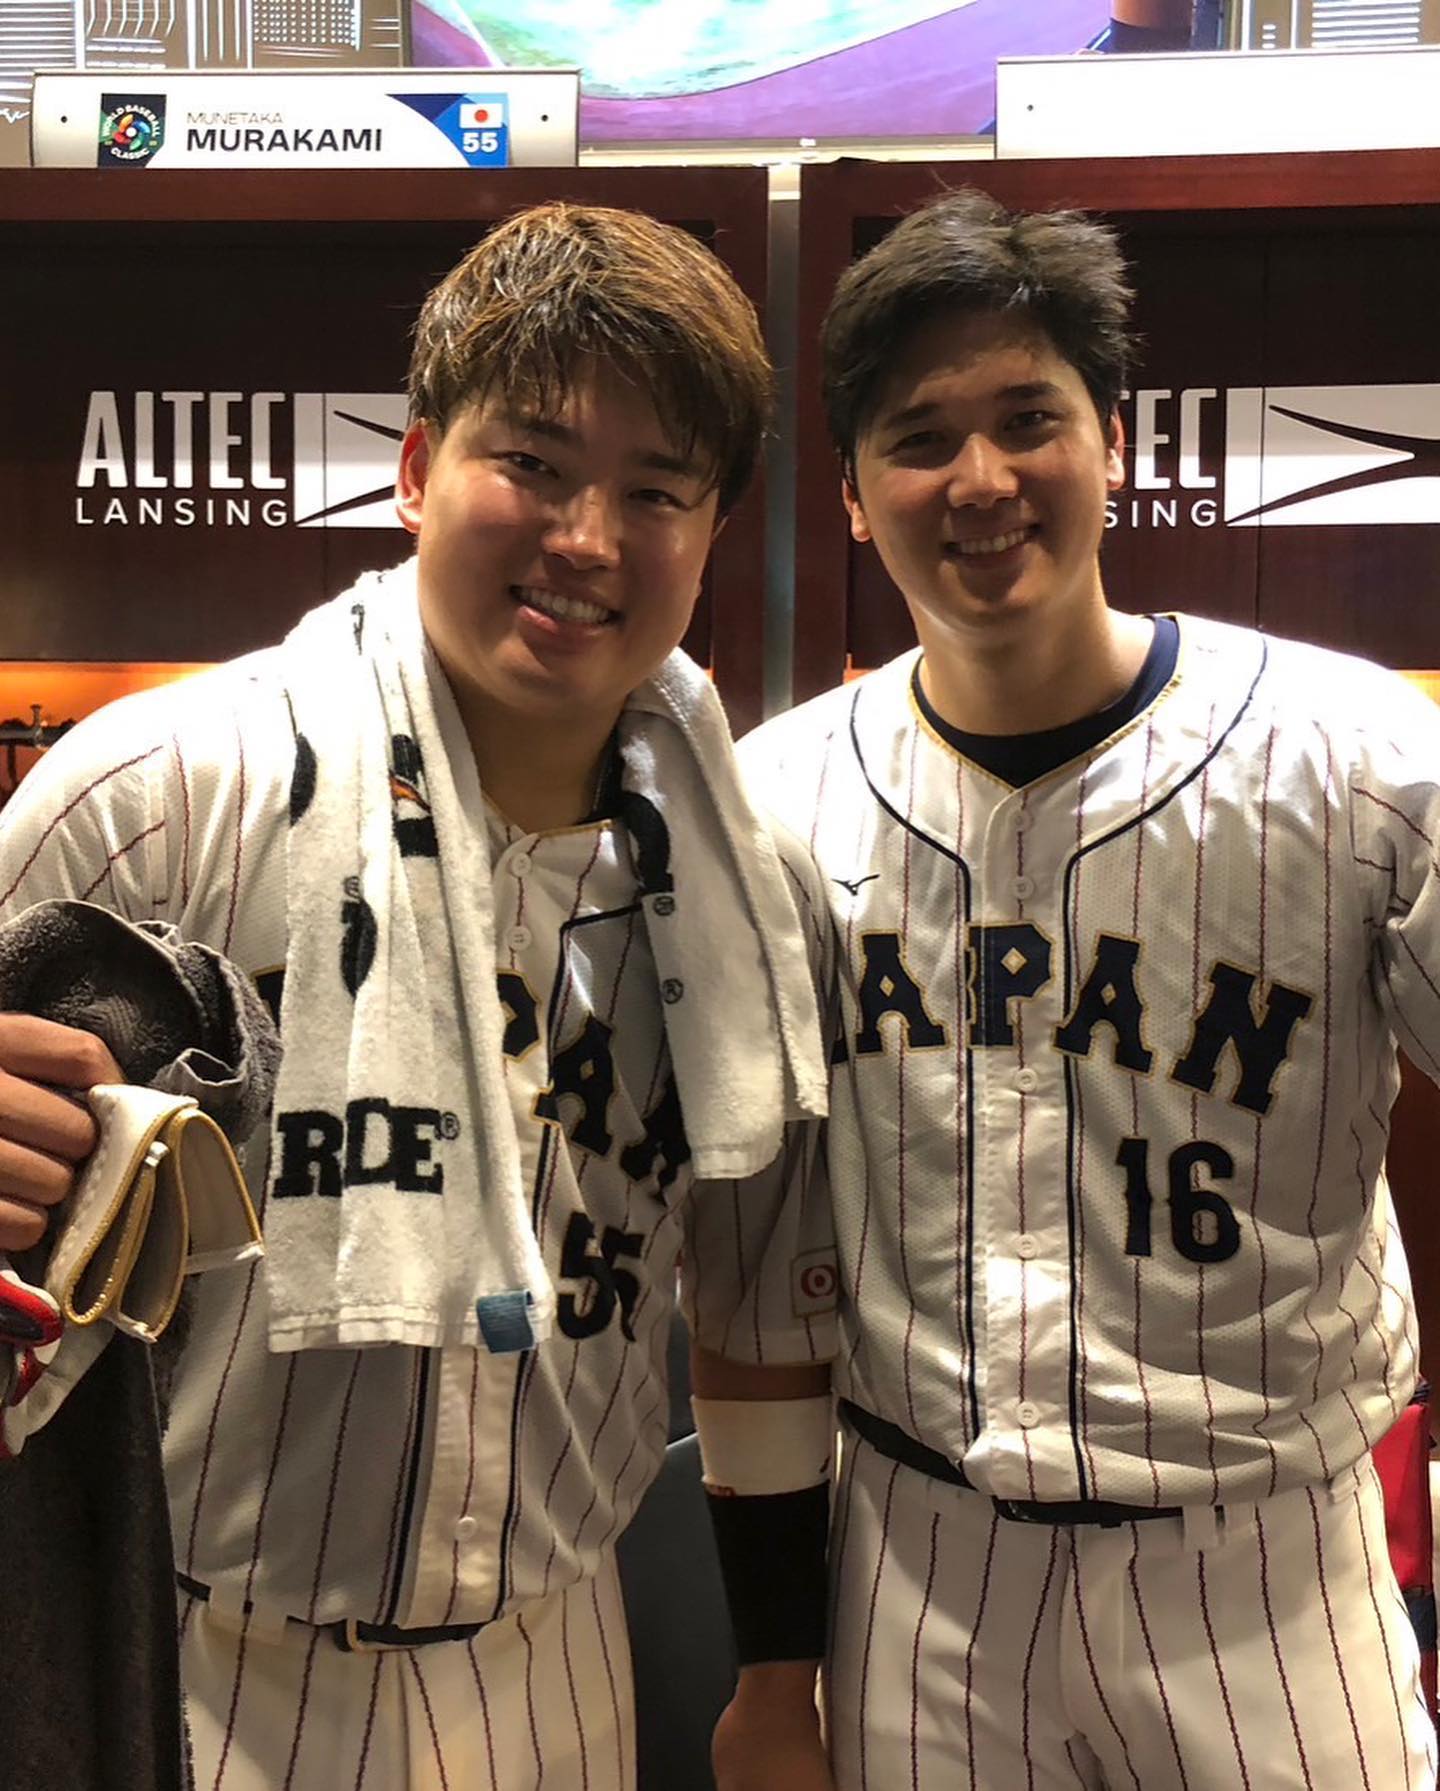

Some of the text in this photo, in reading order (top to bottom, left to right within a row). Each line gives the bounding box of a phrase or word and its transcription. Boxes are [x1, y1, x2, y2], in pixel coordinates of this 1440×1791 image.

[102, 104, 161, 138] WORLD BASEBALL
[186, 112, 284, 125] MUNETAKA
[111, 146, 150, 160] CLASSIC
[187, 128, 383, 152] MURAKAMI
[463, 132, 499, 153] 55
[76, 390, 288, 490] ALTEC
[76, 497, 288, 527] LANSING
[830, 918, 1315, 1115] APAN
[1115, 1136, 1242, 1264] 16
[556, 1209, 646, 1343] 55
